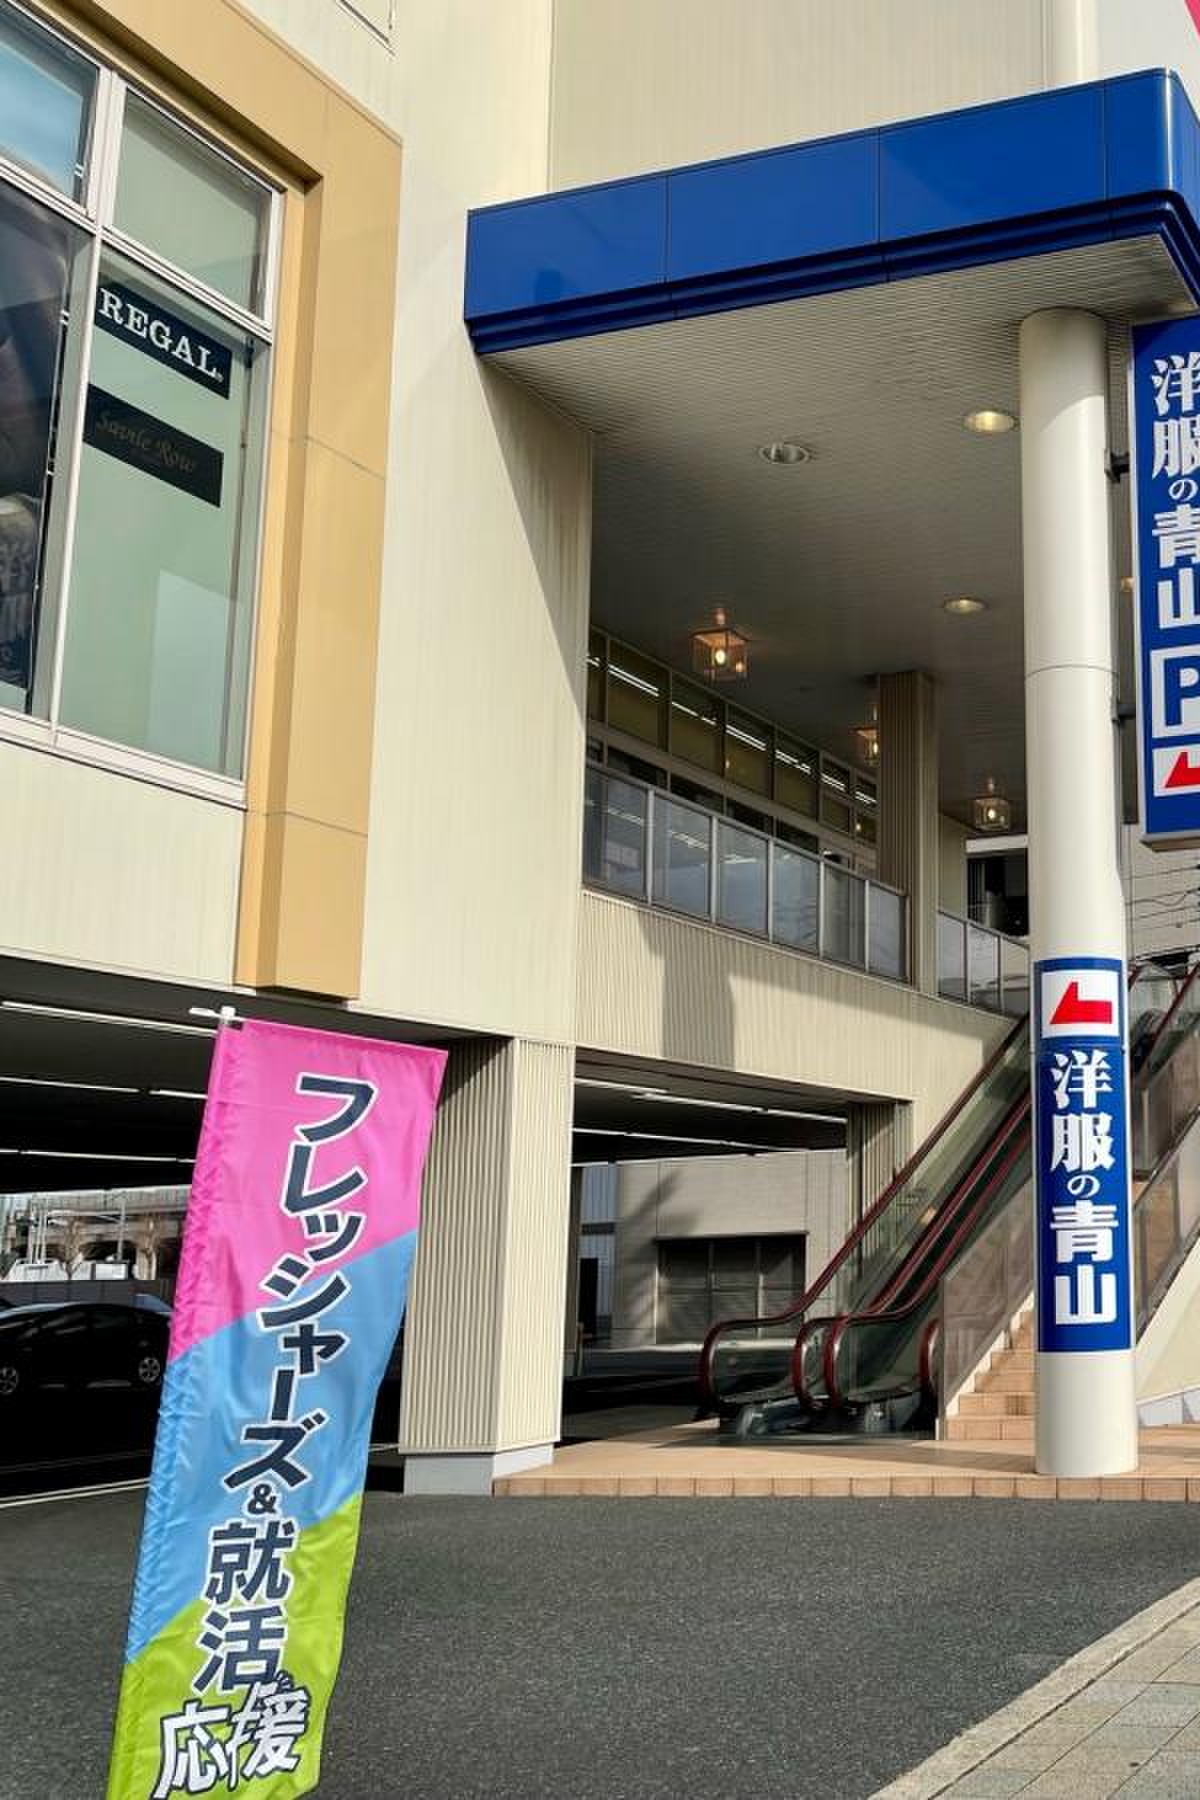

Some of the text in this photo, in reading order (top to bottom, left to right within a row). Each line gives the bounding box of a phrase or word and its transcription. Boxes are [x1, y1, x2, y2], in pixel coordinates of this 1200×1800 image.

[98, 287, 219, 379] REGAL
[1050, 1048, 1119, 1325] 洋服の青山
[150, 1673, 311, 1799] 応援
